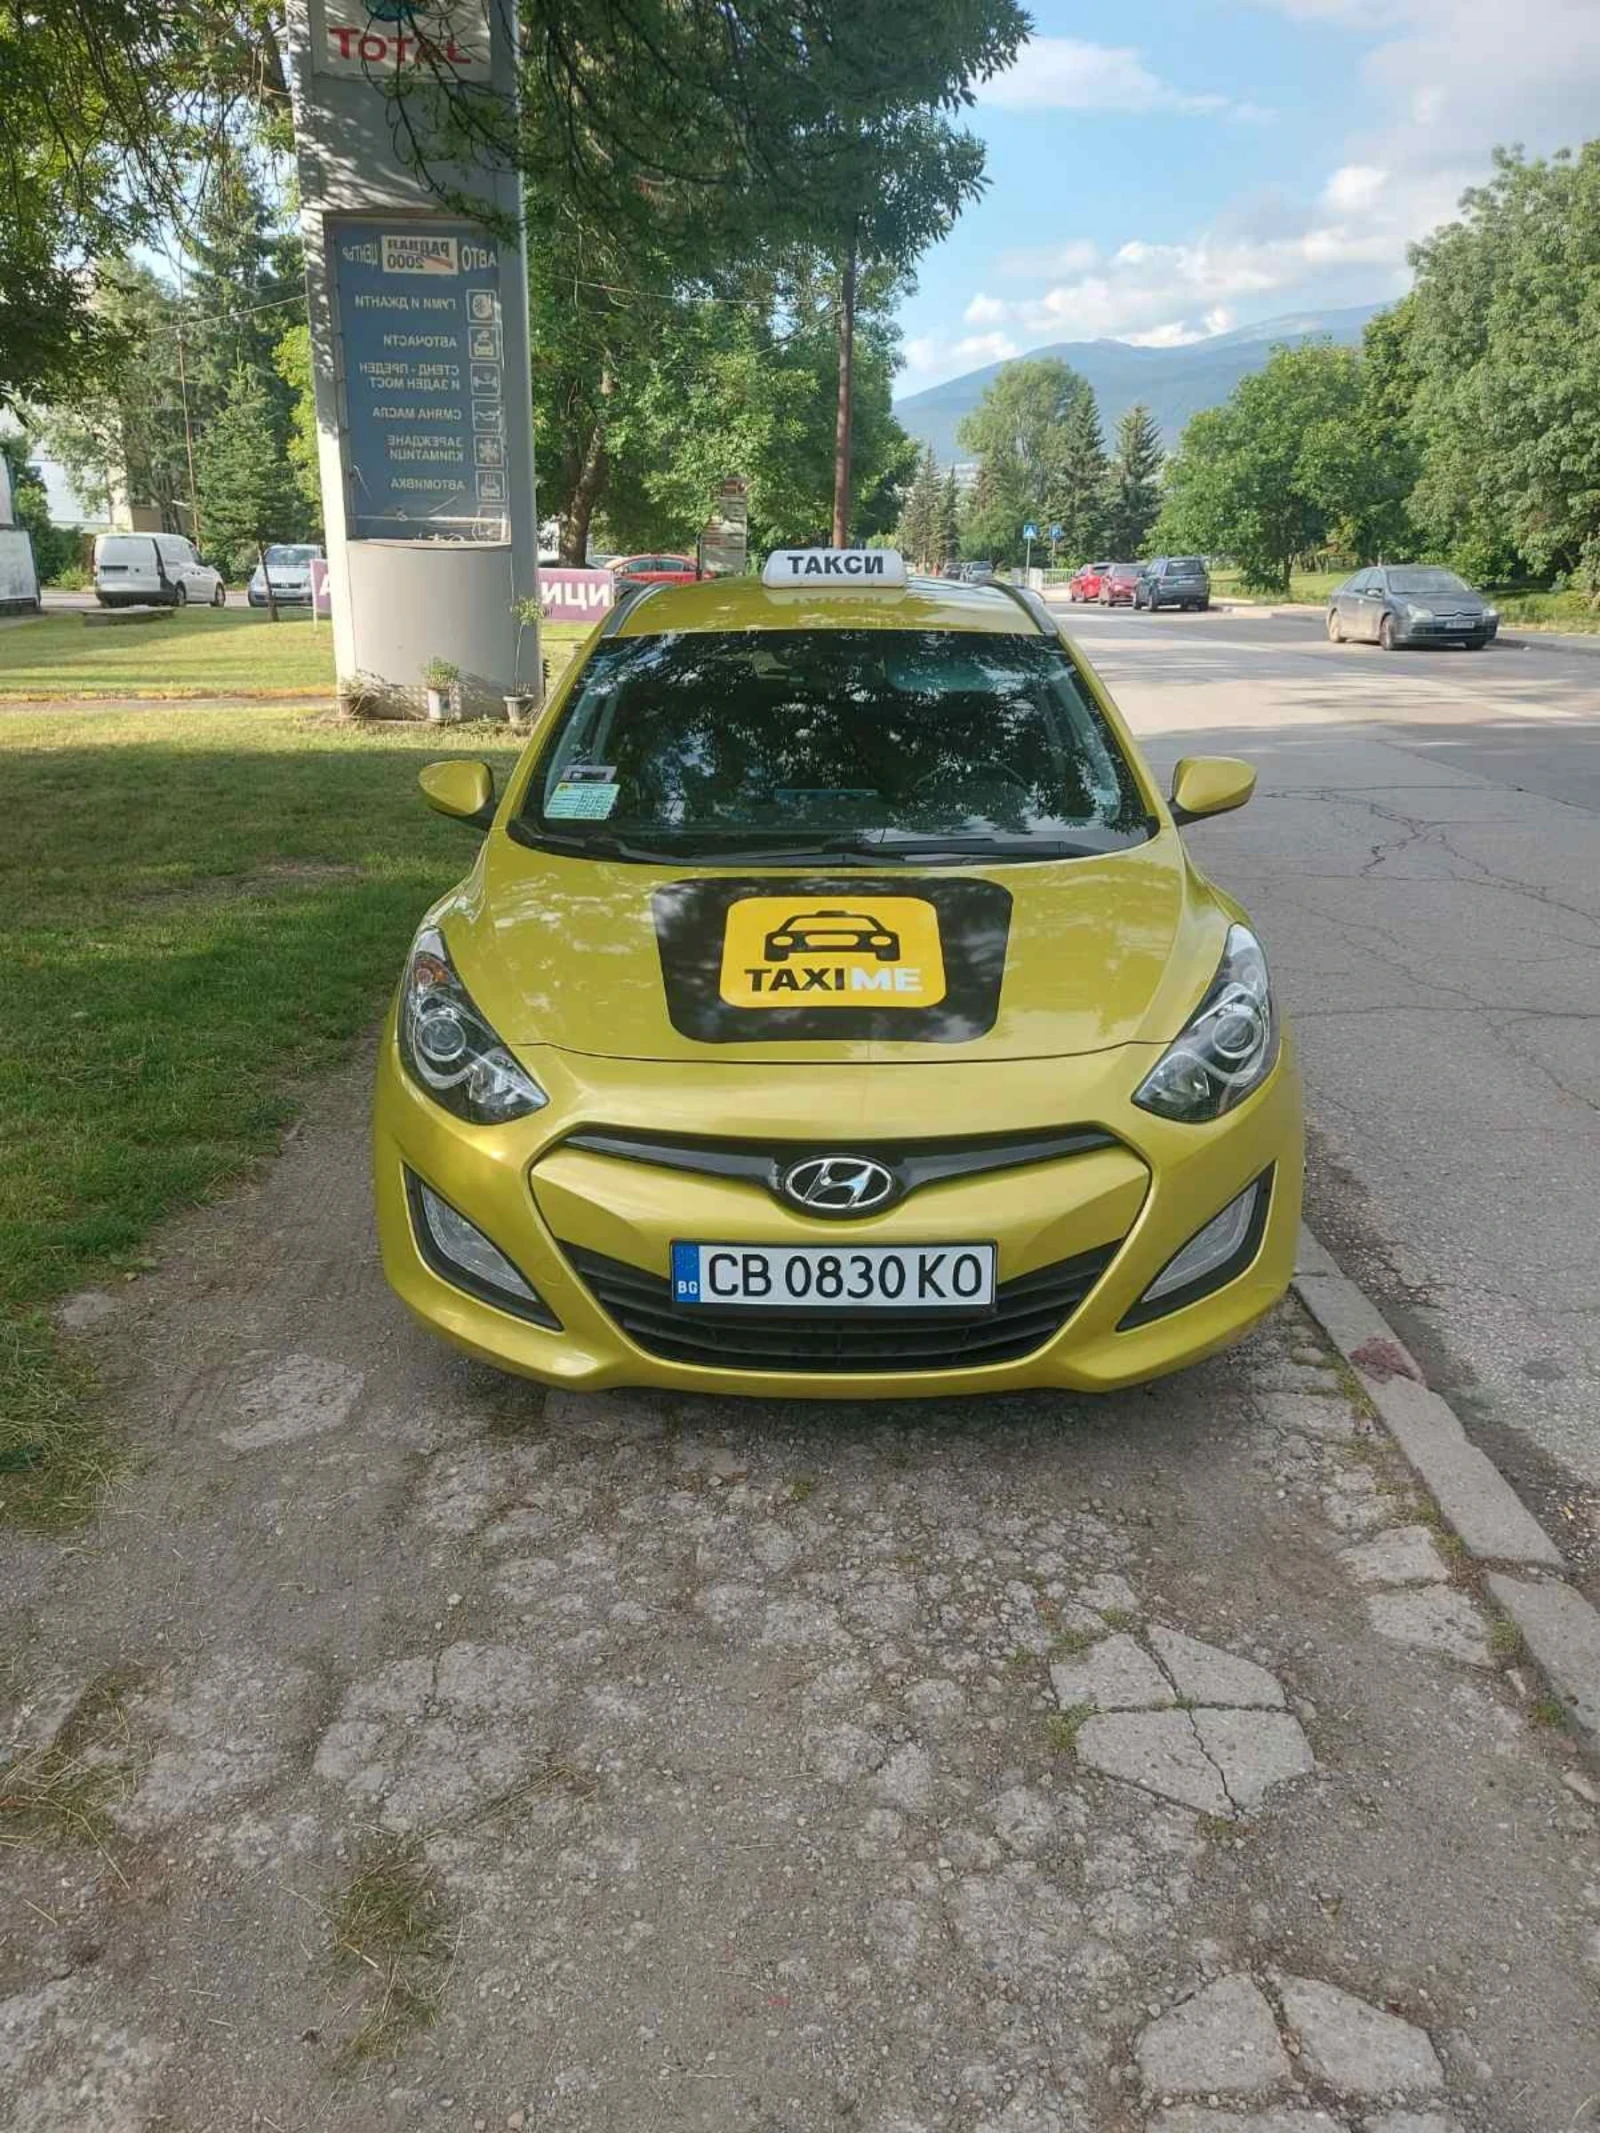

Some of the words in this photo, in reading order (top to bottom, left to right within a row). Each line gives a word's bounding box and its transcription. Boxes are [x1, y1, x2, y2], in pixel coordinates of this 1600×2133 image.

[786, 556, 884, 574] ТАКСИ
[708, 1253, 772, 1297] CB
[785, 1254, 906, 1299] 0830
[678, 1280, 698, 1295] BG
